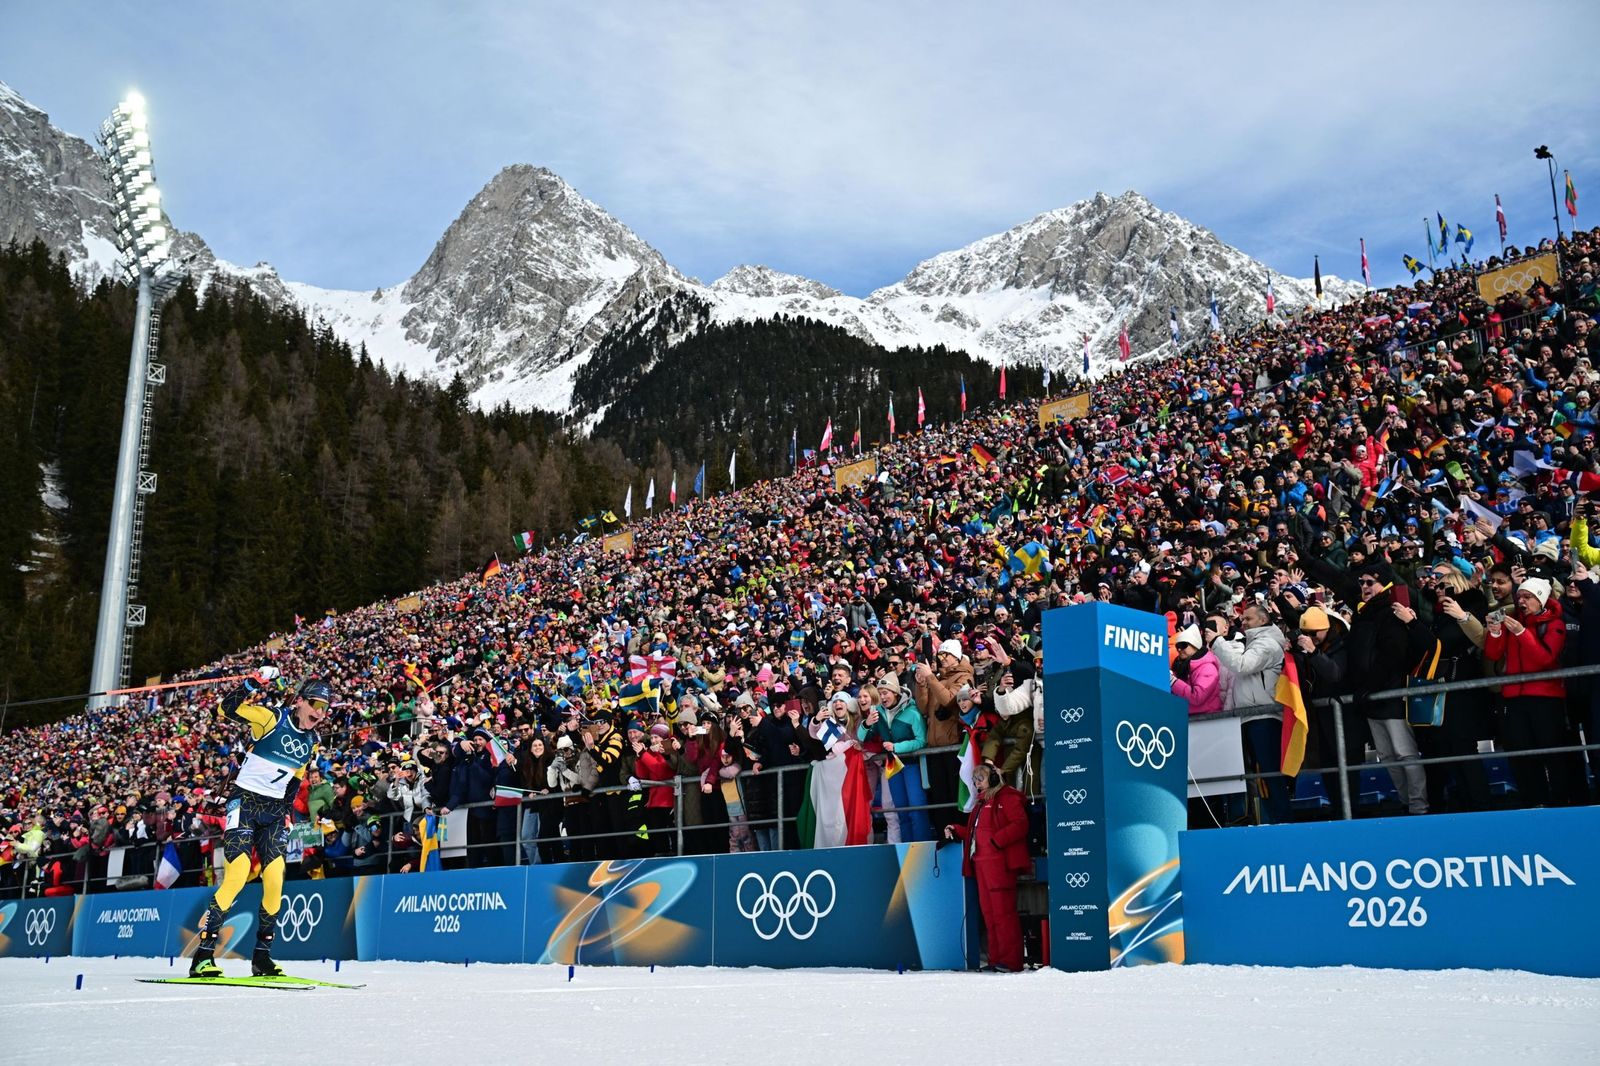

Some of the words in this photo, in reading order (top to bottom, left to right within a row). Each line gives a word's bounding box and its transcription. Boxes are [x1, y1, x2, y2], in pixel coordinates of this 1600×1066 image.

[1104, 624, 1163, 657] FINISH
[270, 768, 288, 784] 7
[1222, 860, 1377, 895] MILANO
[1385, 853, 1577, 890] CORTINA
[394, 894, 447, 913] MILANO
[448, 891, 507, 911] CORTINA
[1347, 895, 1428, 928] 2026
[96, 909, 128, 924] MILANO
[128, 907, 160, 922] CORTINA
[433, 914, 461, 933] 2026
[117, 924, 134, 938] 2026
